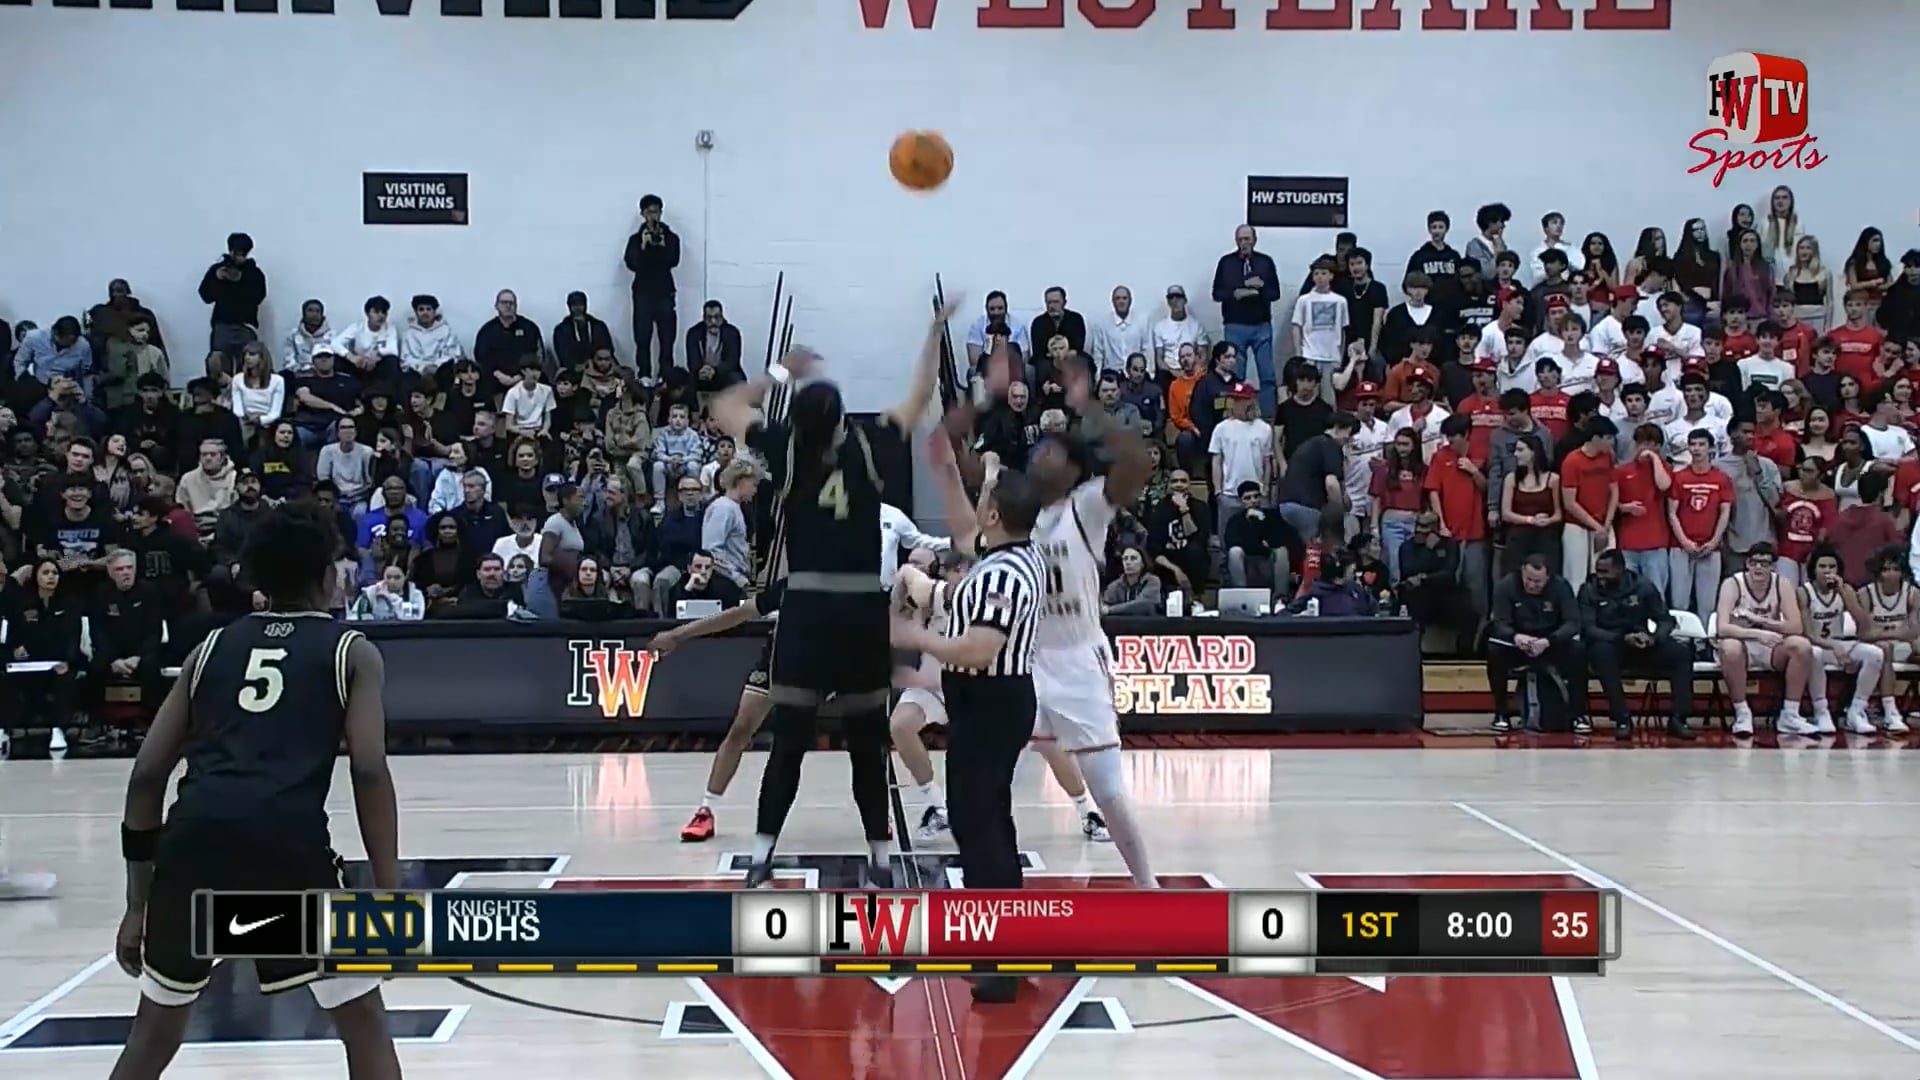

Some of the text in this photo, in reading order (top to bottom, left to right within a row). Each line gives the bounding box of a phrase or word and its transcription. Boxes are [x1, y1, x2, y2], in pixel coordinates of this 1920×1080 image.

[385, 182, 446, 195] VISITING
[1252, 191, 1345, 205] HW STUDENTS
[377, 196, 455, 209] TEAM FANS
[818, 469, 849, 520] 4
[1820, 622, 1832, 639] 5
[1110, 635, 1256, 673] RVARD
[238, 648, 288, 712] 5
[567, 640, 659, 717] HW
